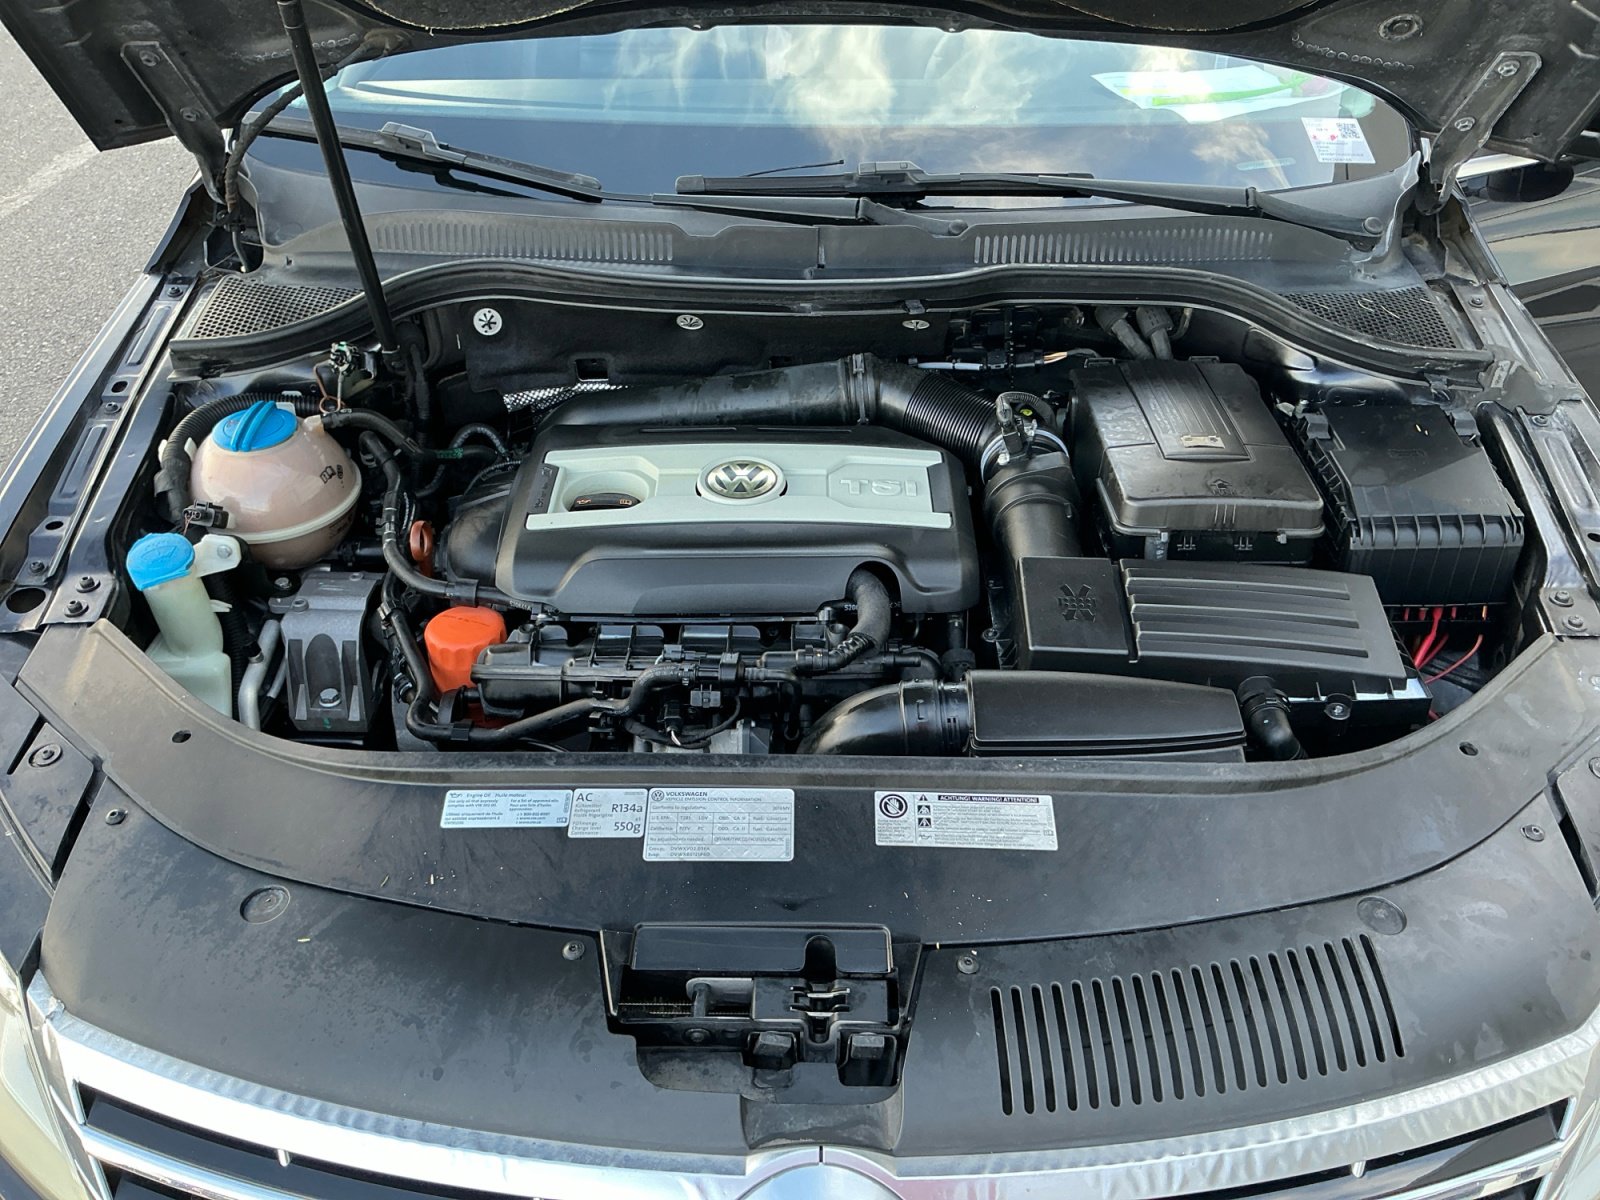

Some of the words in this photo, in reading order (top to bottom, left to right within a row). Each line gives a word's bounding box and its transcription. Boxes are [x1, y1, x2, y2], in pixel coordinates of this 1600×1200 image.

[840, 479, 917, 497] TSI
[576, 793, 593, 802] AC
[611, 803, 643, 813] R134a
[613, 821, 641, 834] 550g
